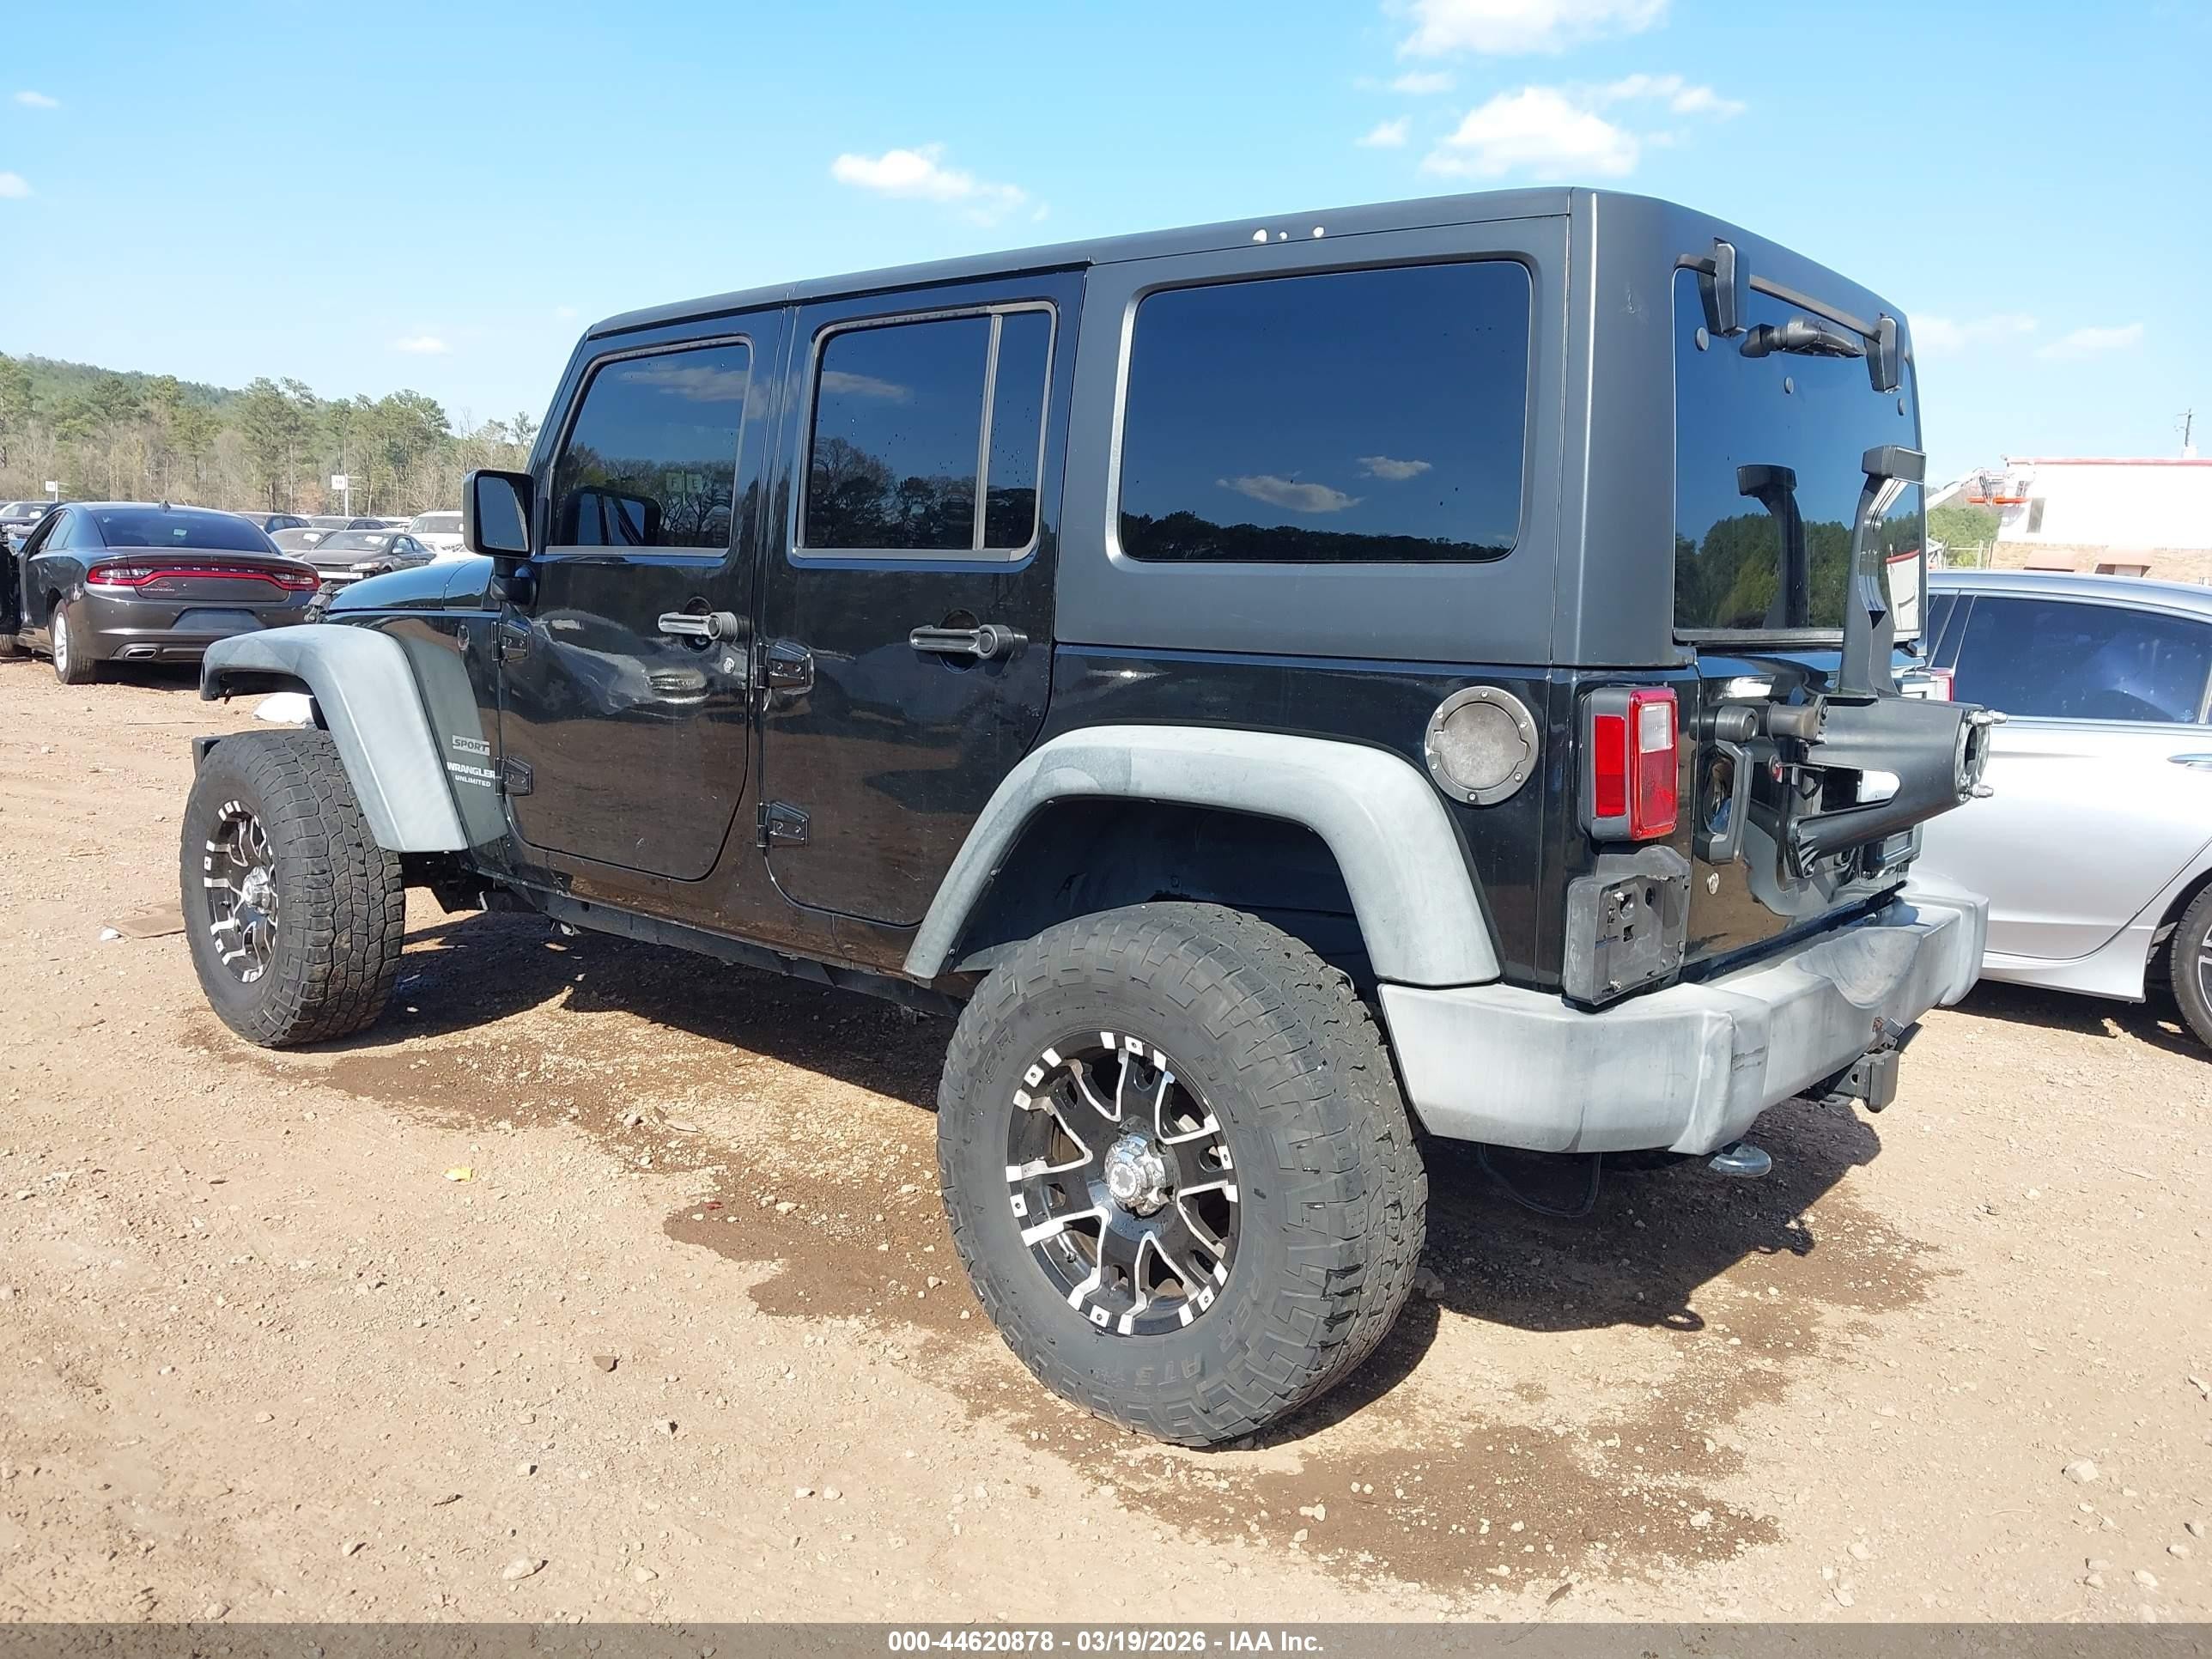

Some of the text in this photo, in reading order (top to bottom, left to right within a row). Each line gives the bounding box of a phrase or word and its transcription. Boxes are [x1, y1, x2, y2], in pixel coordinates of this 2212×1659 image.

[454, 738, 489, 752] SPORT
[447, 762, 495, 779] WRANGLER
[454, 775, 491, 787] UNLIMITED
